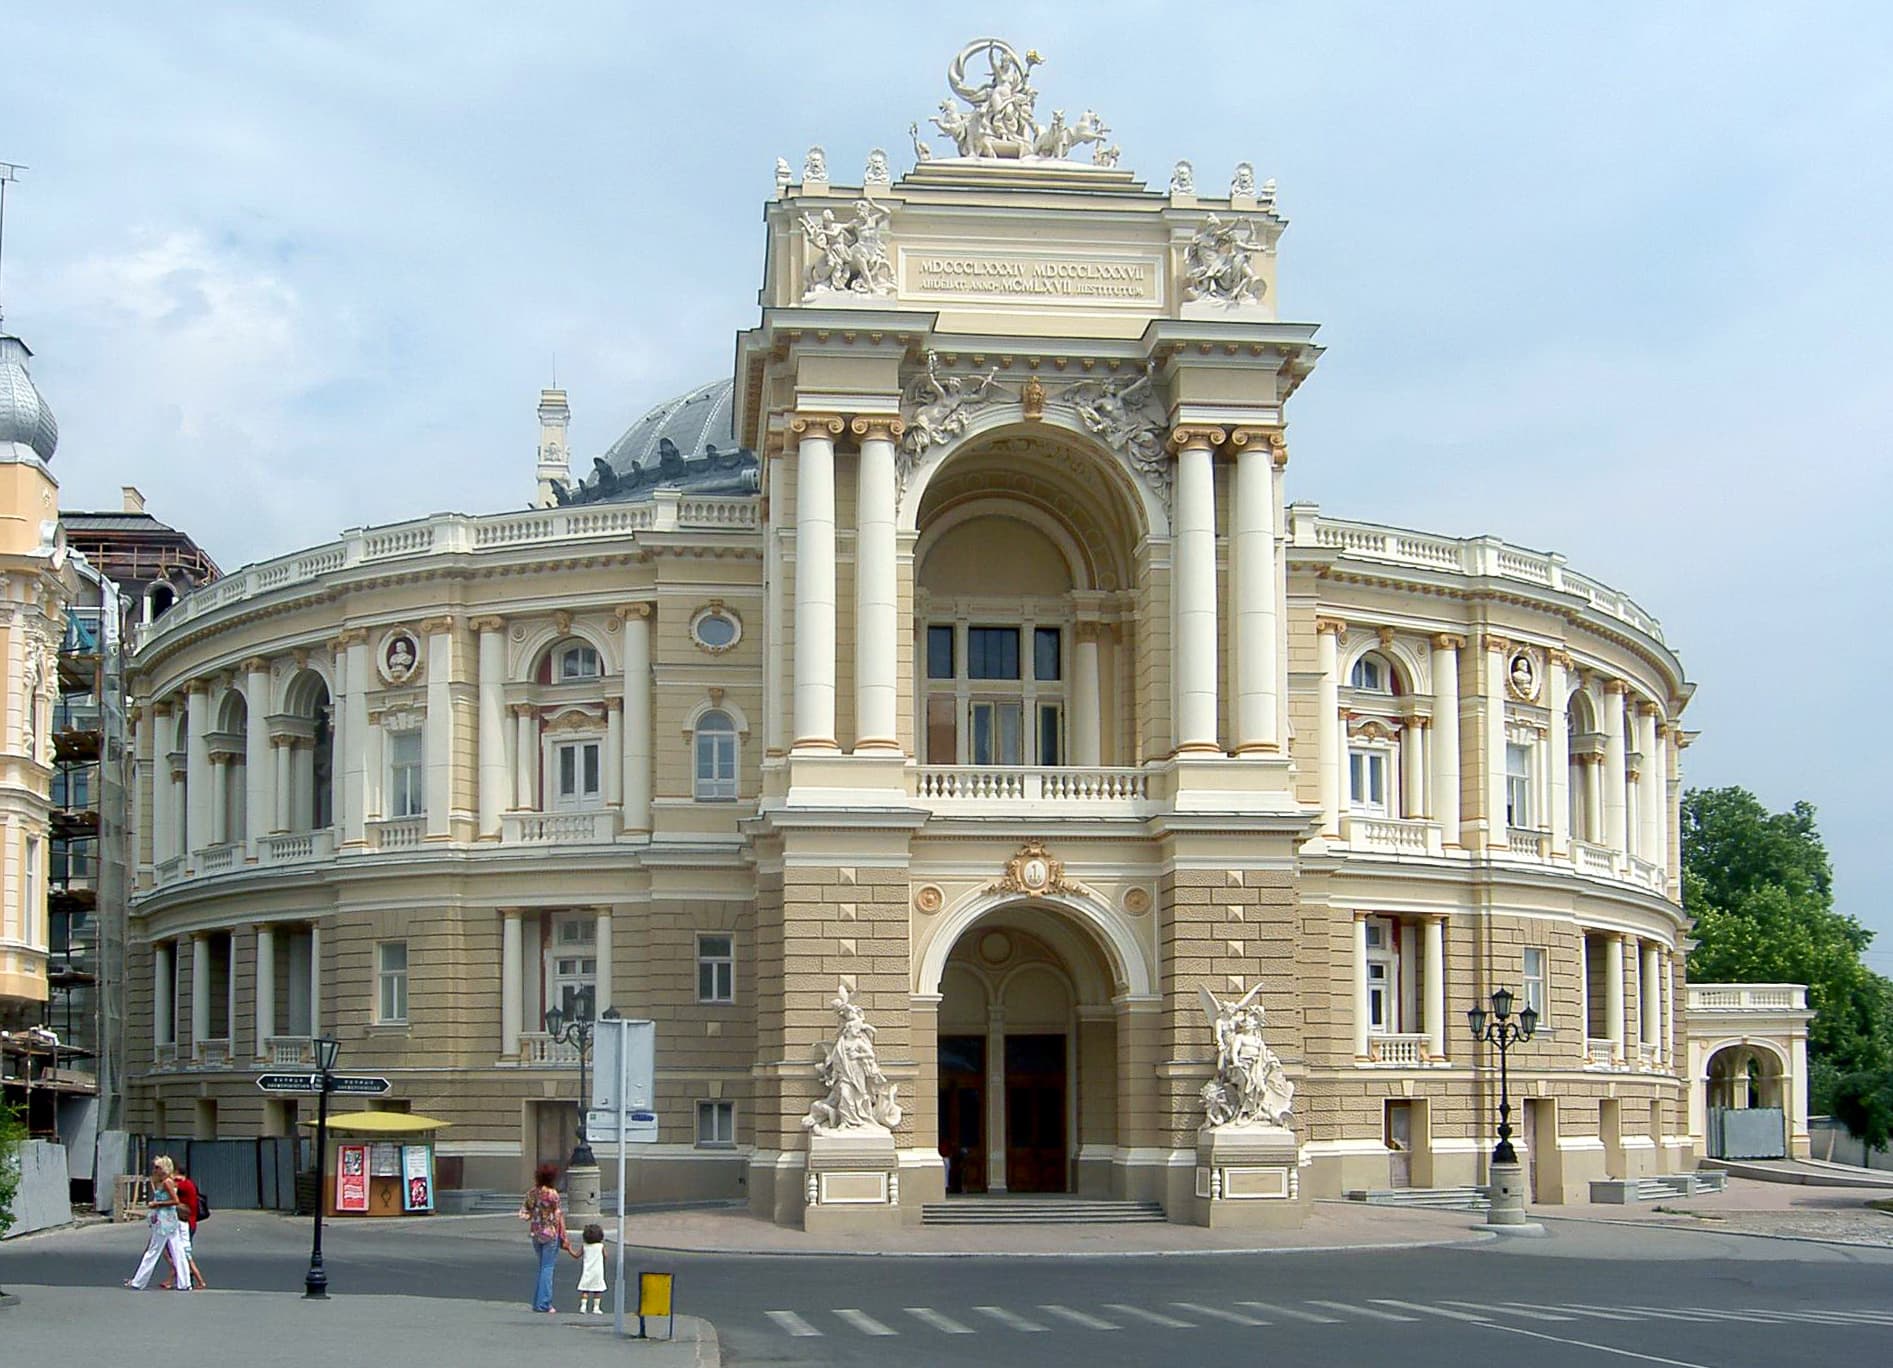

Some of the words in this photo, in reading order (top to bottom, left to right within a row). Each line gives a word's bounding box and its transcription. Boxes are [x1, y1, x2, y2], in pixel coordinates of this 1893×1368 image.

[920, 260, 1024, 277] MDCCCLXXXIV
[1032, 263, 1143, 281] MDCCCLXXXVII
[999, 278, 1072, 294] MCMLXVII
